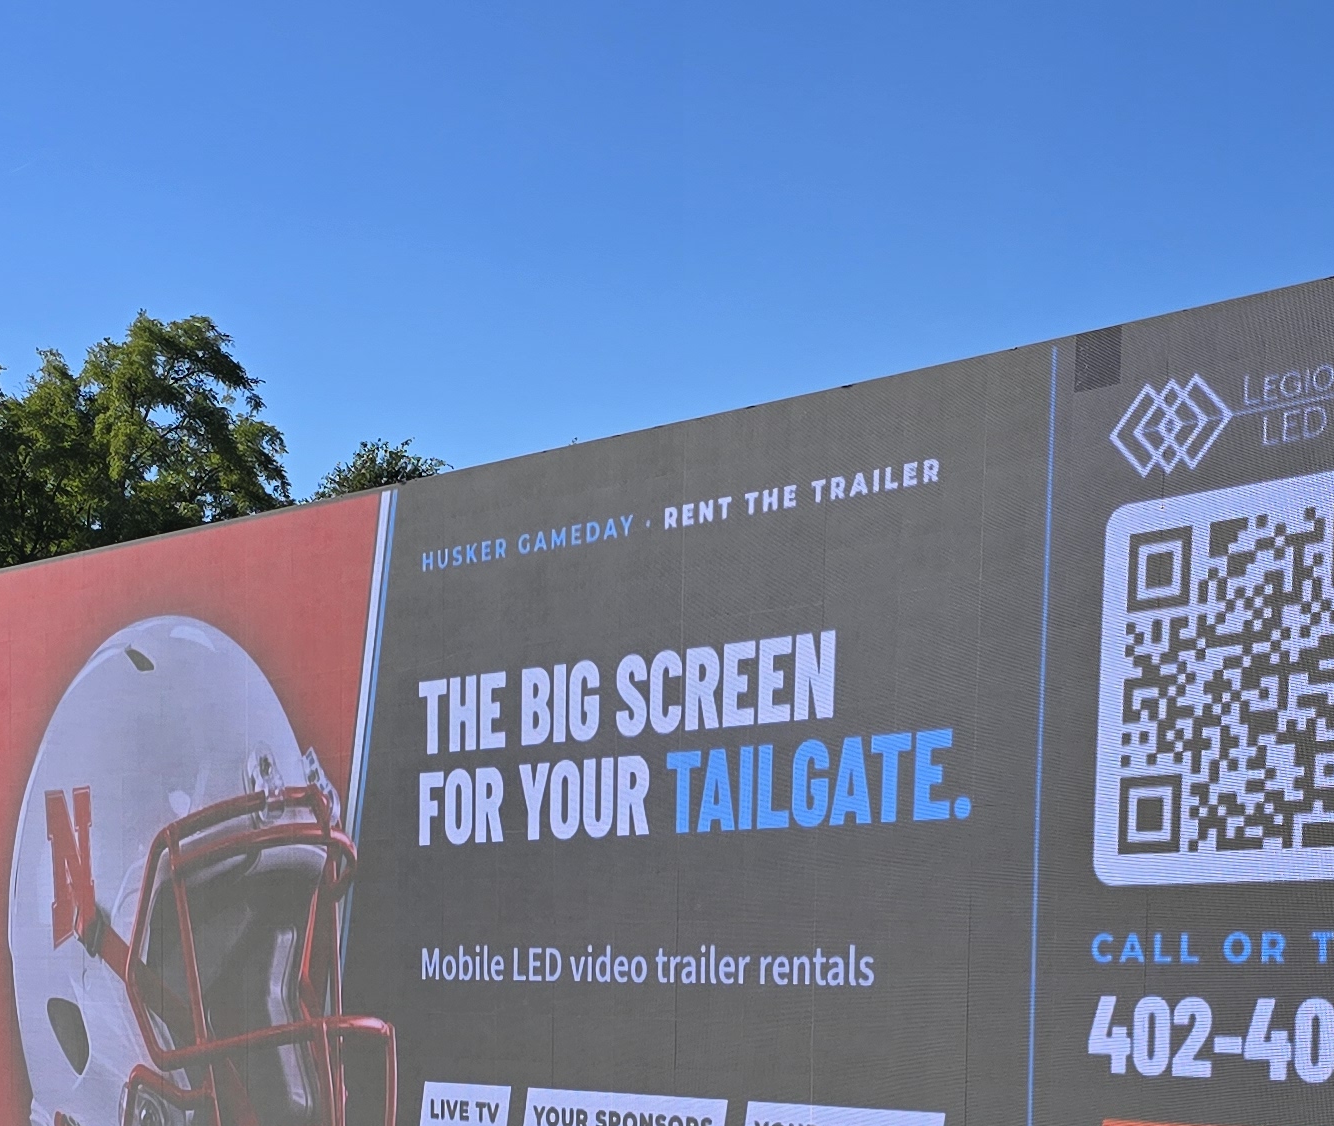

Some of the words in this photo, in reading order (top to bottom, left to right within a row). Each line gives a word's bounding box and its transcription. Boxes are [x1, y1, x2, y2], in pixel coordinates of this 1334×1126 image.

[1262, 406, 1327, 446] LED
[422, 538, 507, 572] HUSKER
[518, 514, 634, 554] GAMEDAY
[664, 496, 732, 530] RENT
[744, 486, 797, 515] THE
[811, 458, 940, 503] TRAILER
[418, 670, 506, 754] THE
[521, 659, 600, 746] BIG
[616, 630, 836, 737] SCREEN
[419, 767, 503, 846] FOR
[519, 755, 649, 840] YOUR
[667, 729, 972, 833] TAILGATE.
[421, 945, 504, 982] Mobile
[512, 947, 562, 982] LED
[570, 945, 648, 984] video
[656, 944, 749, 985] trailer
[758, 944, 875, 987] rentals
[1090, 932, 1200, 964] CALL
[1222, 932, 1287, 964] OR
[430, 1098, 469, 1121] LIVE
[474, 1101, 500, 1124] TV
